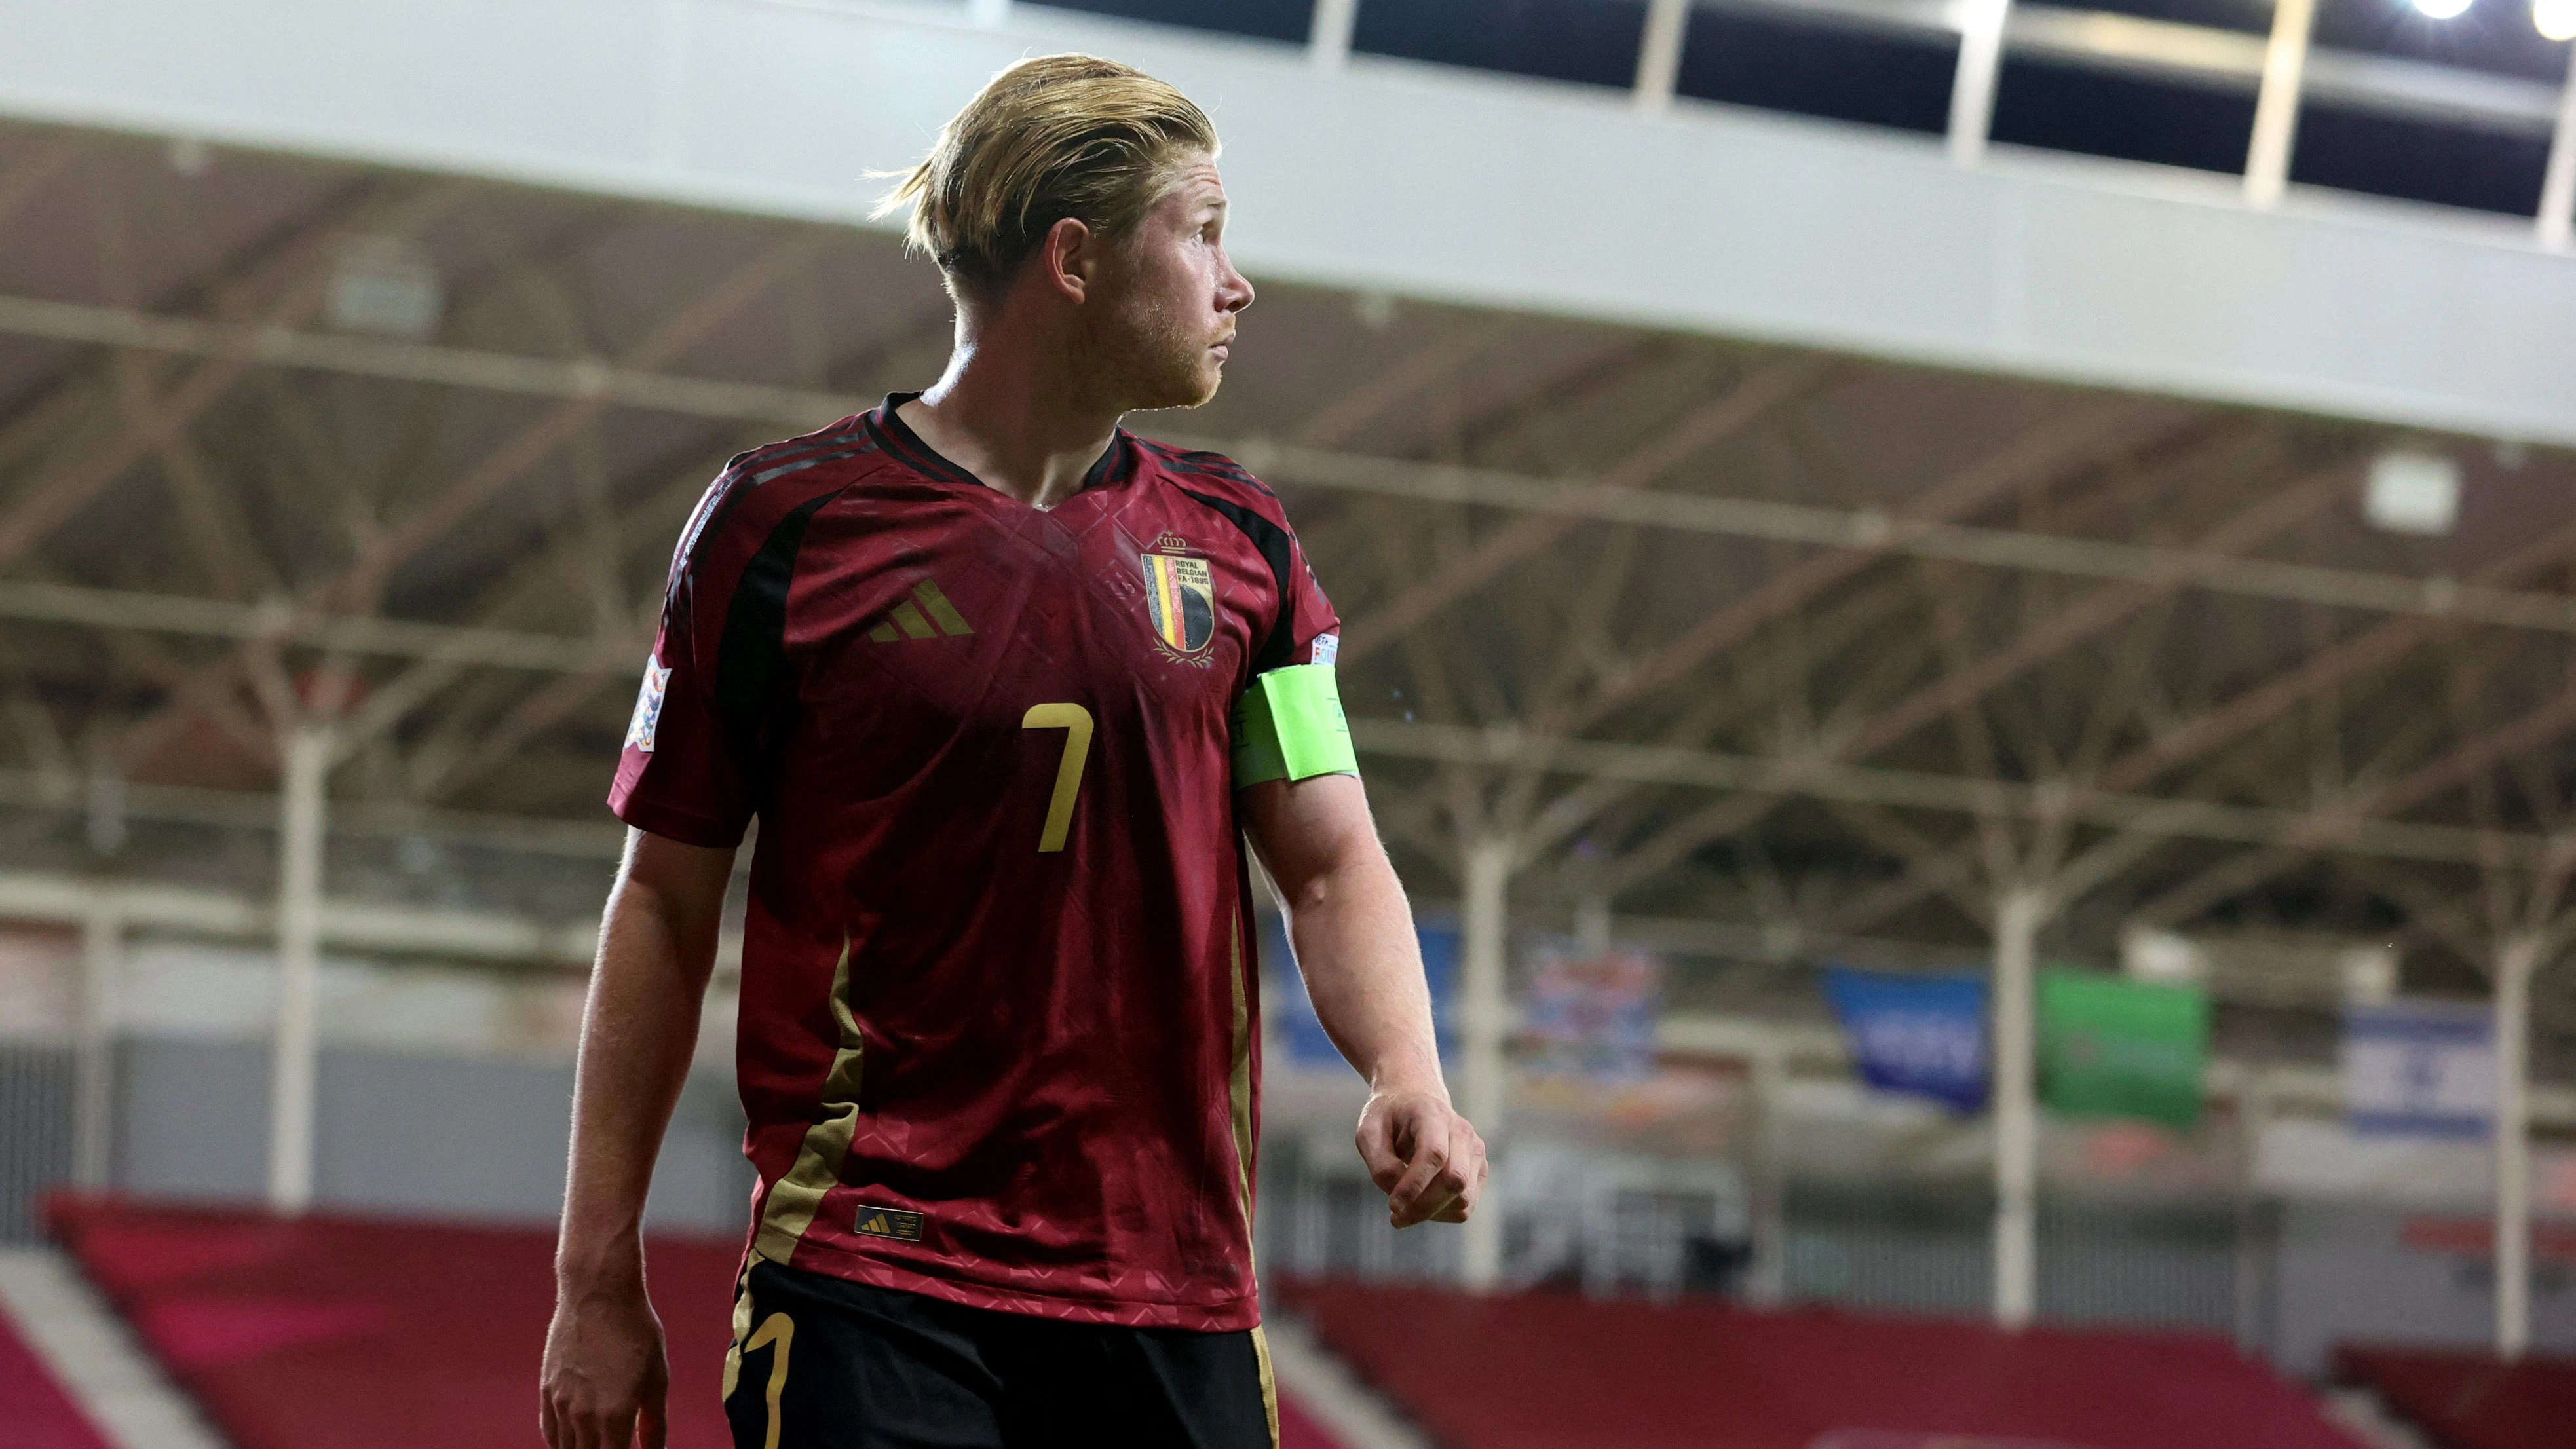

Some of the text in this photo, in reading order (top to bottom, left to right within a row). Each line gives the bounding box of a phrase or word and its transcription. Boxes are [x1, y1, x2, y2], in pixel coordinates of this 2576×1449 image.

[1175, 560, 1198, 569] ROYAL
[1177, 568, 1207, 576] BELGIAN
[1021, 702, 1094, 852] 7
[744, 1312, 795, 1449] 7
